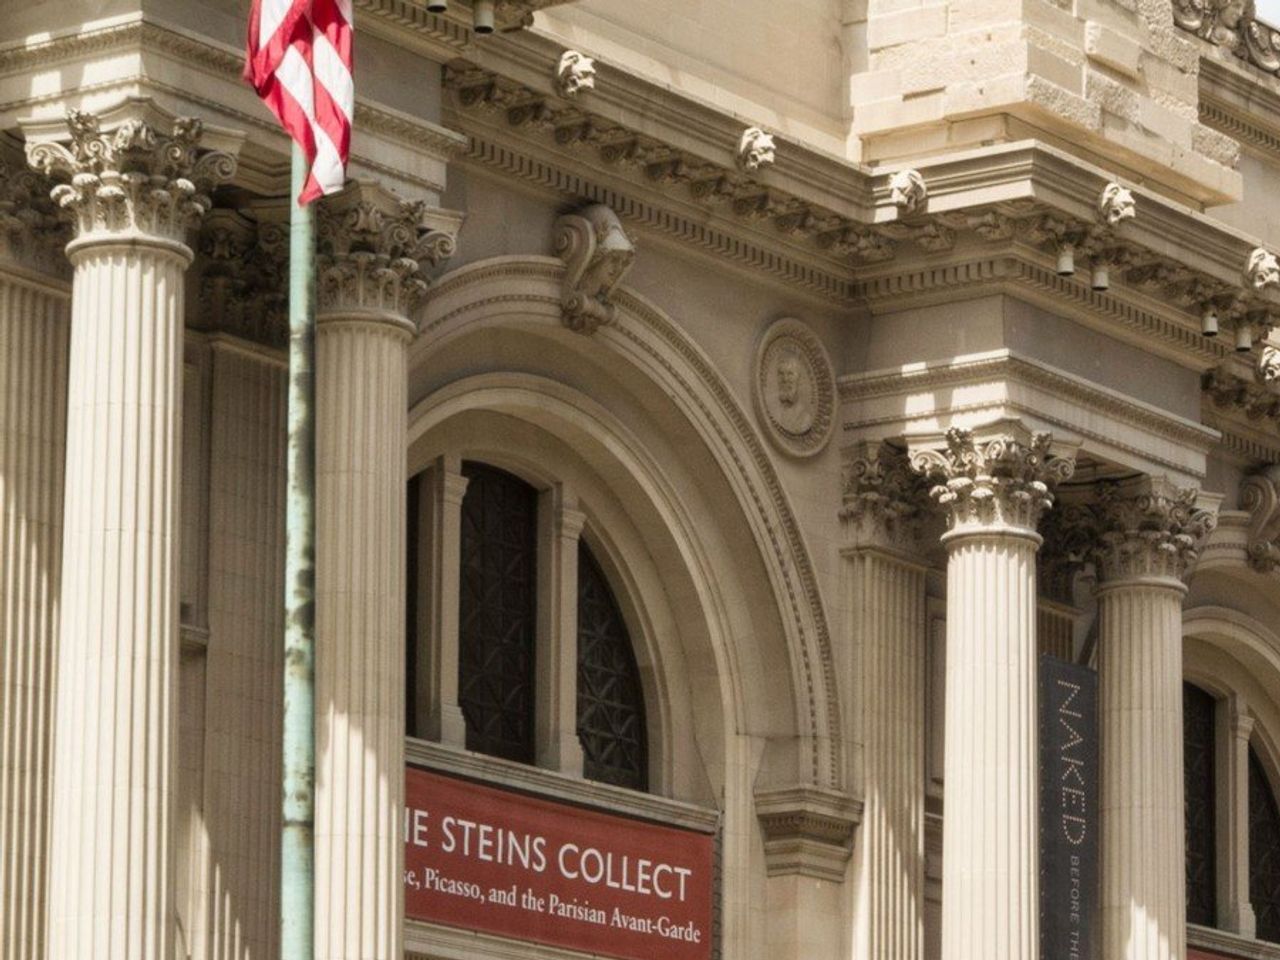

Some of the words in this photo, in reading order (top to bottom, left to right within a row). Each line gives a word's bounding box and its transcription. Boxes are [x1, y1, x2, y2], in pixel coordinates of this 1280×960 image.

[1057, 679, 1086, 845] NAKED
[441, 816, 547, 873] STEINS
[558, 843, 692, 902] COLLECT
[1070, 855, 1080, 924] BEFORE
[425, 867, 486, 903] Picasso,
[488, 885, 517, 908] and
[521, 888, 545, 912] the
[548, 893, 606, 925] Parisian
[610, 907, 701, 943] Avant-Garde
